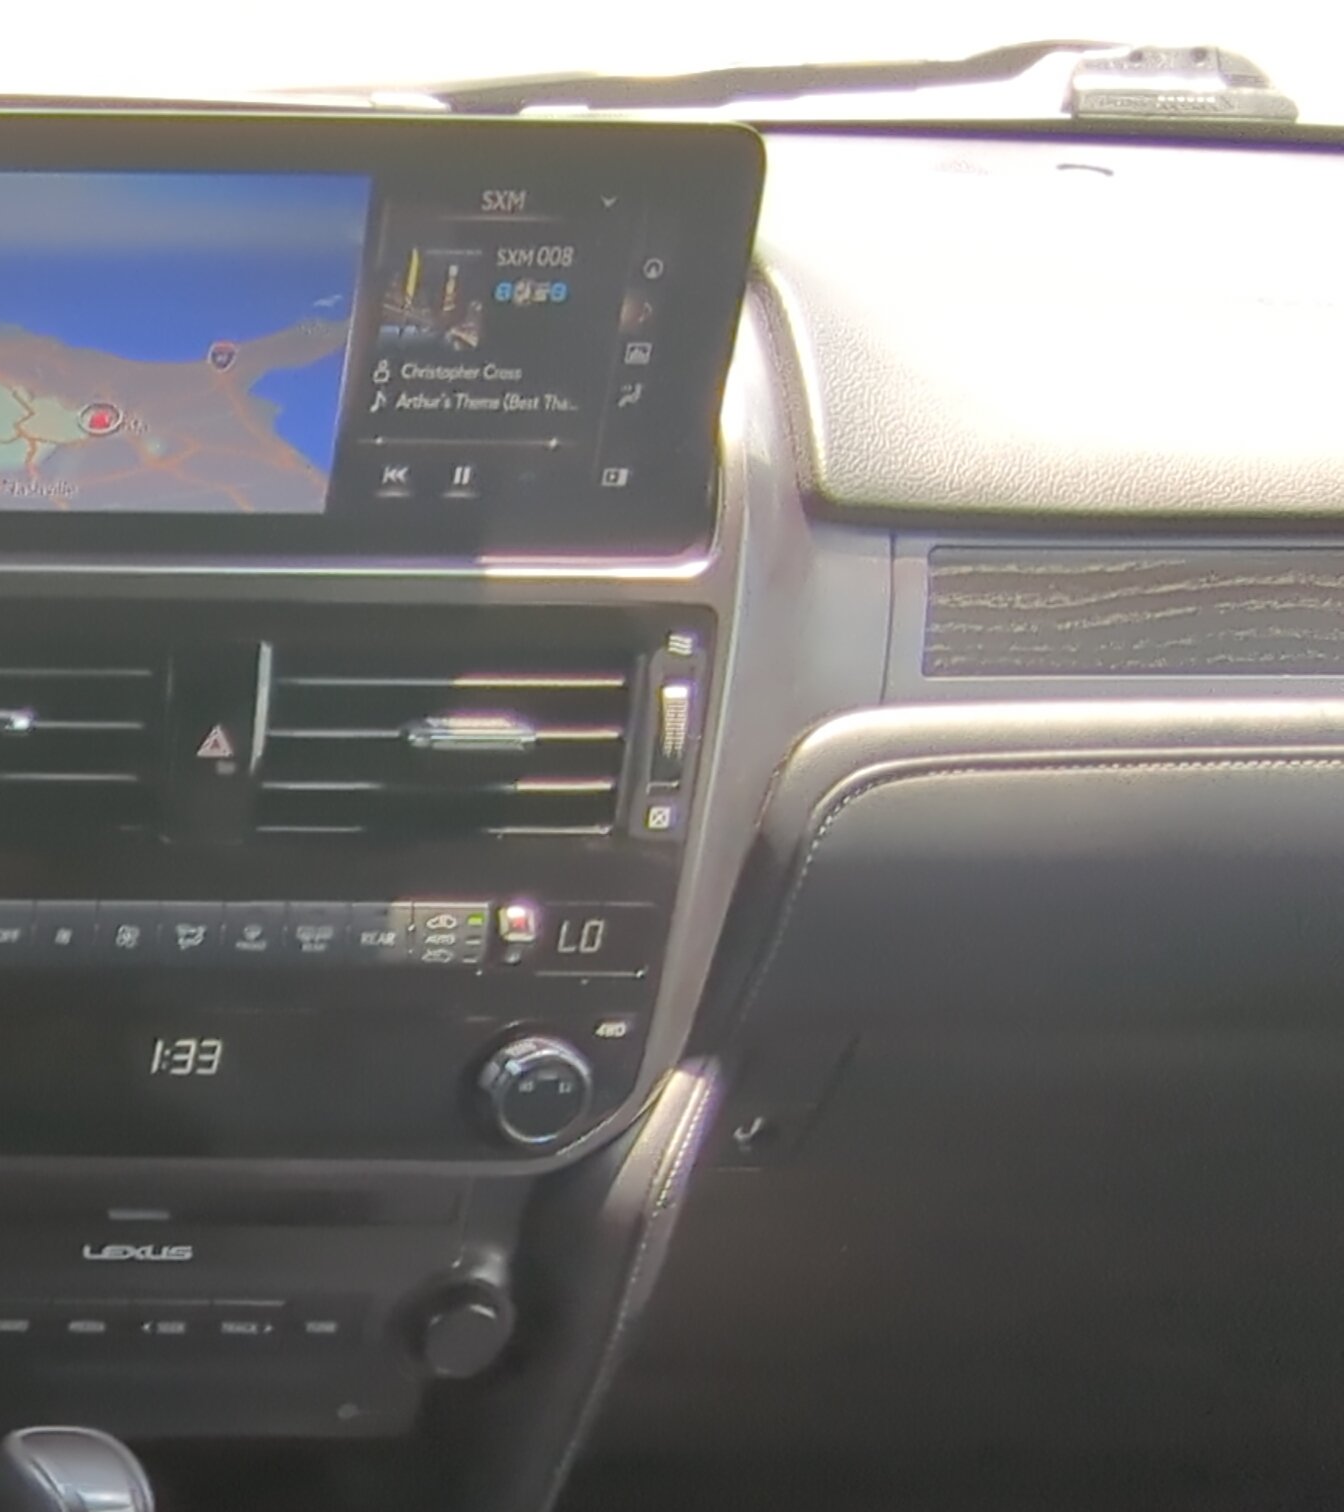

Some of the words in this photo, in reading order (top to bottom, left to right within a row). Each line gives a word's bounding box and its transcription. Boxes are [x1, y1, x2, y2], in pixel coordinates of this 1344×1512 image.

[481, 189, 527, 211] SXM
[496, 248, 533, 266] SXM
[536, 245, 575, 266] 008
[400, 362, 480, 382] Christopher
[360, 931, 397, 947] REAR
[557, 919, 604, 953] LO
[150, 1038, 223, 1075] 1:33
[82, 1244, 193, 1261] LEXUS
